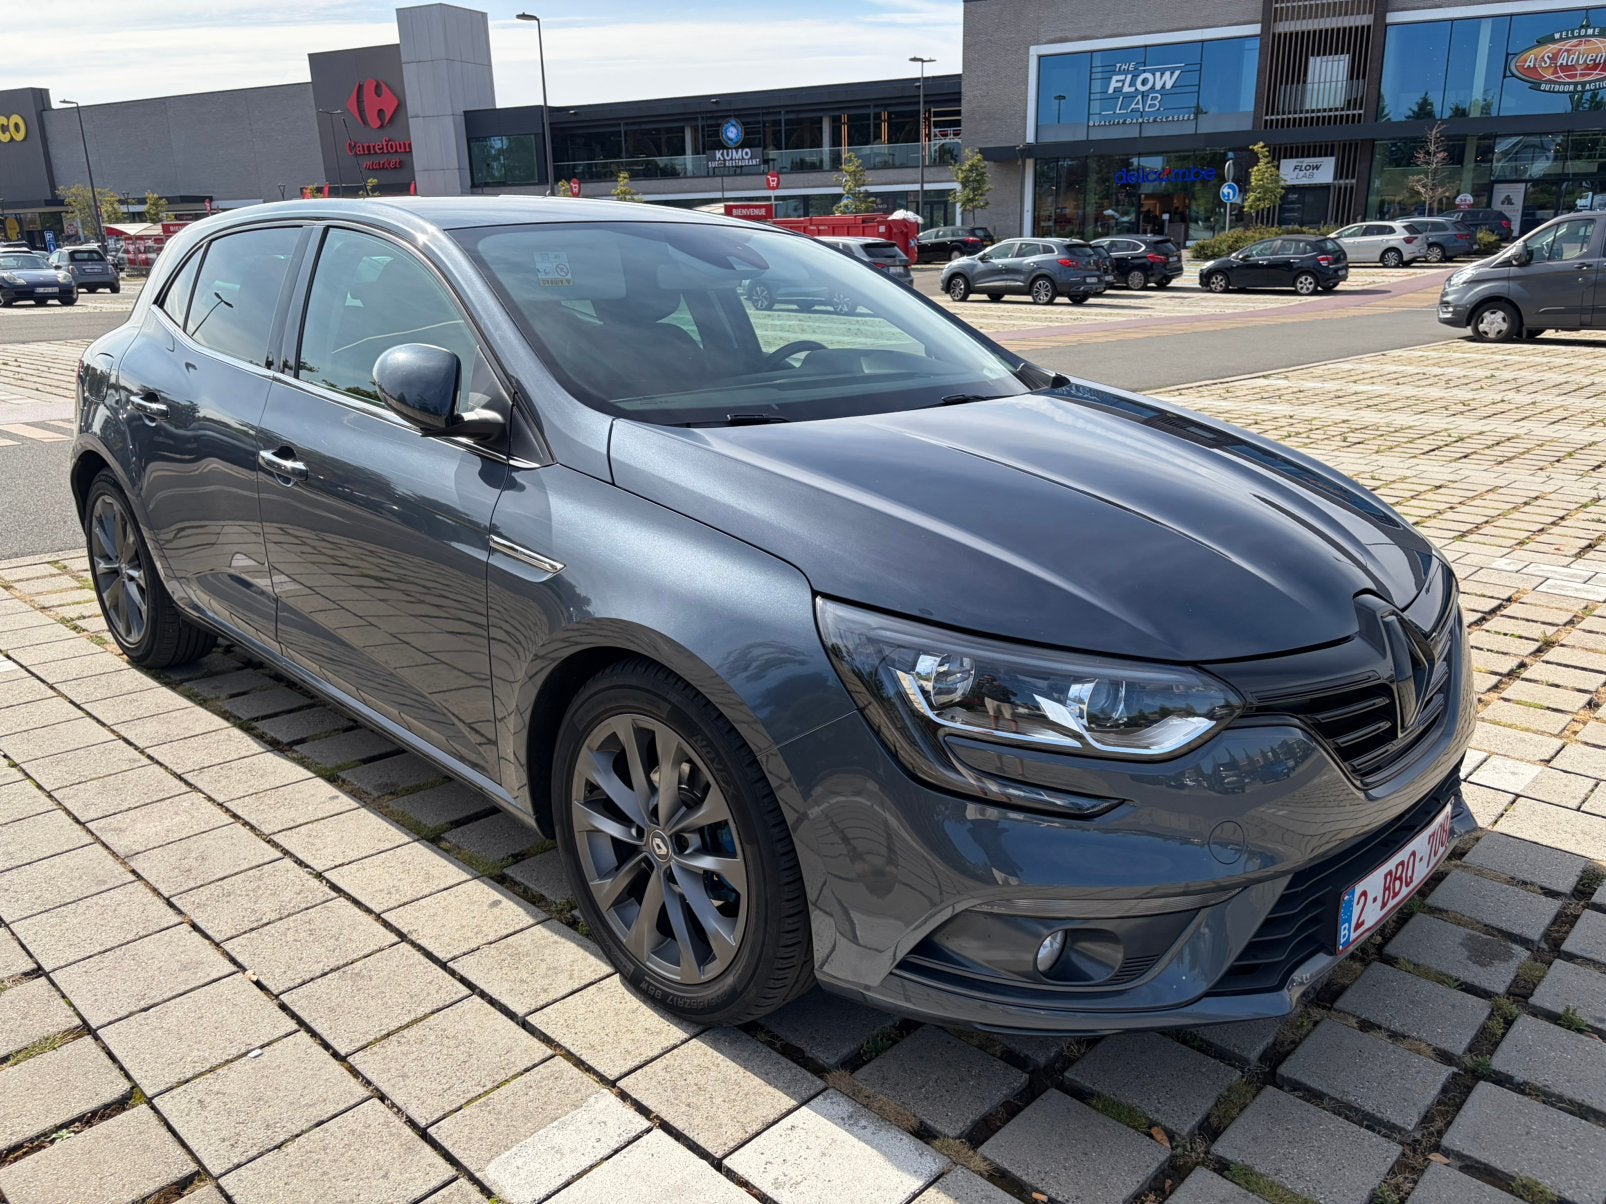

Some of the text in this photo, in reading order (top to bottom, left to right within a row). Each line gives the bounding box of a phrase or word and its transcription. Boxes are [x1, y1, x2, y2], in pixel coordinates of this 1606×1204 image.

[1554, 28, 1600, 39] WELCOME
[1115, 62, 1136, 72] THE
[1107, 70, 1181, 94] FLOW
[1540, 83, 1575, 92] OUTDOOR
[1088, 113, 1195, 127] QUALITY DANCE CLASSES
[346, 137, 412, 156] Carrefour
[715, 148, 752, 160] KUMO
[363, 158, 402, 171] market
[726, 159, 760, 167] RESTAURANT
[1292, 163, 1322, 172] FLOW
[732, 208, 766, 216] BIENVENUE
[1340, 922, 1349, 944] B
